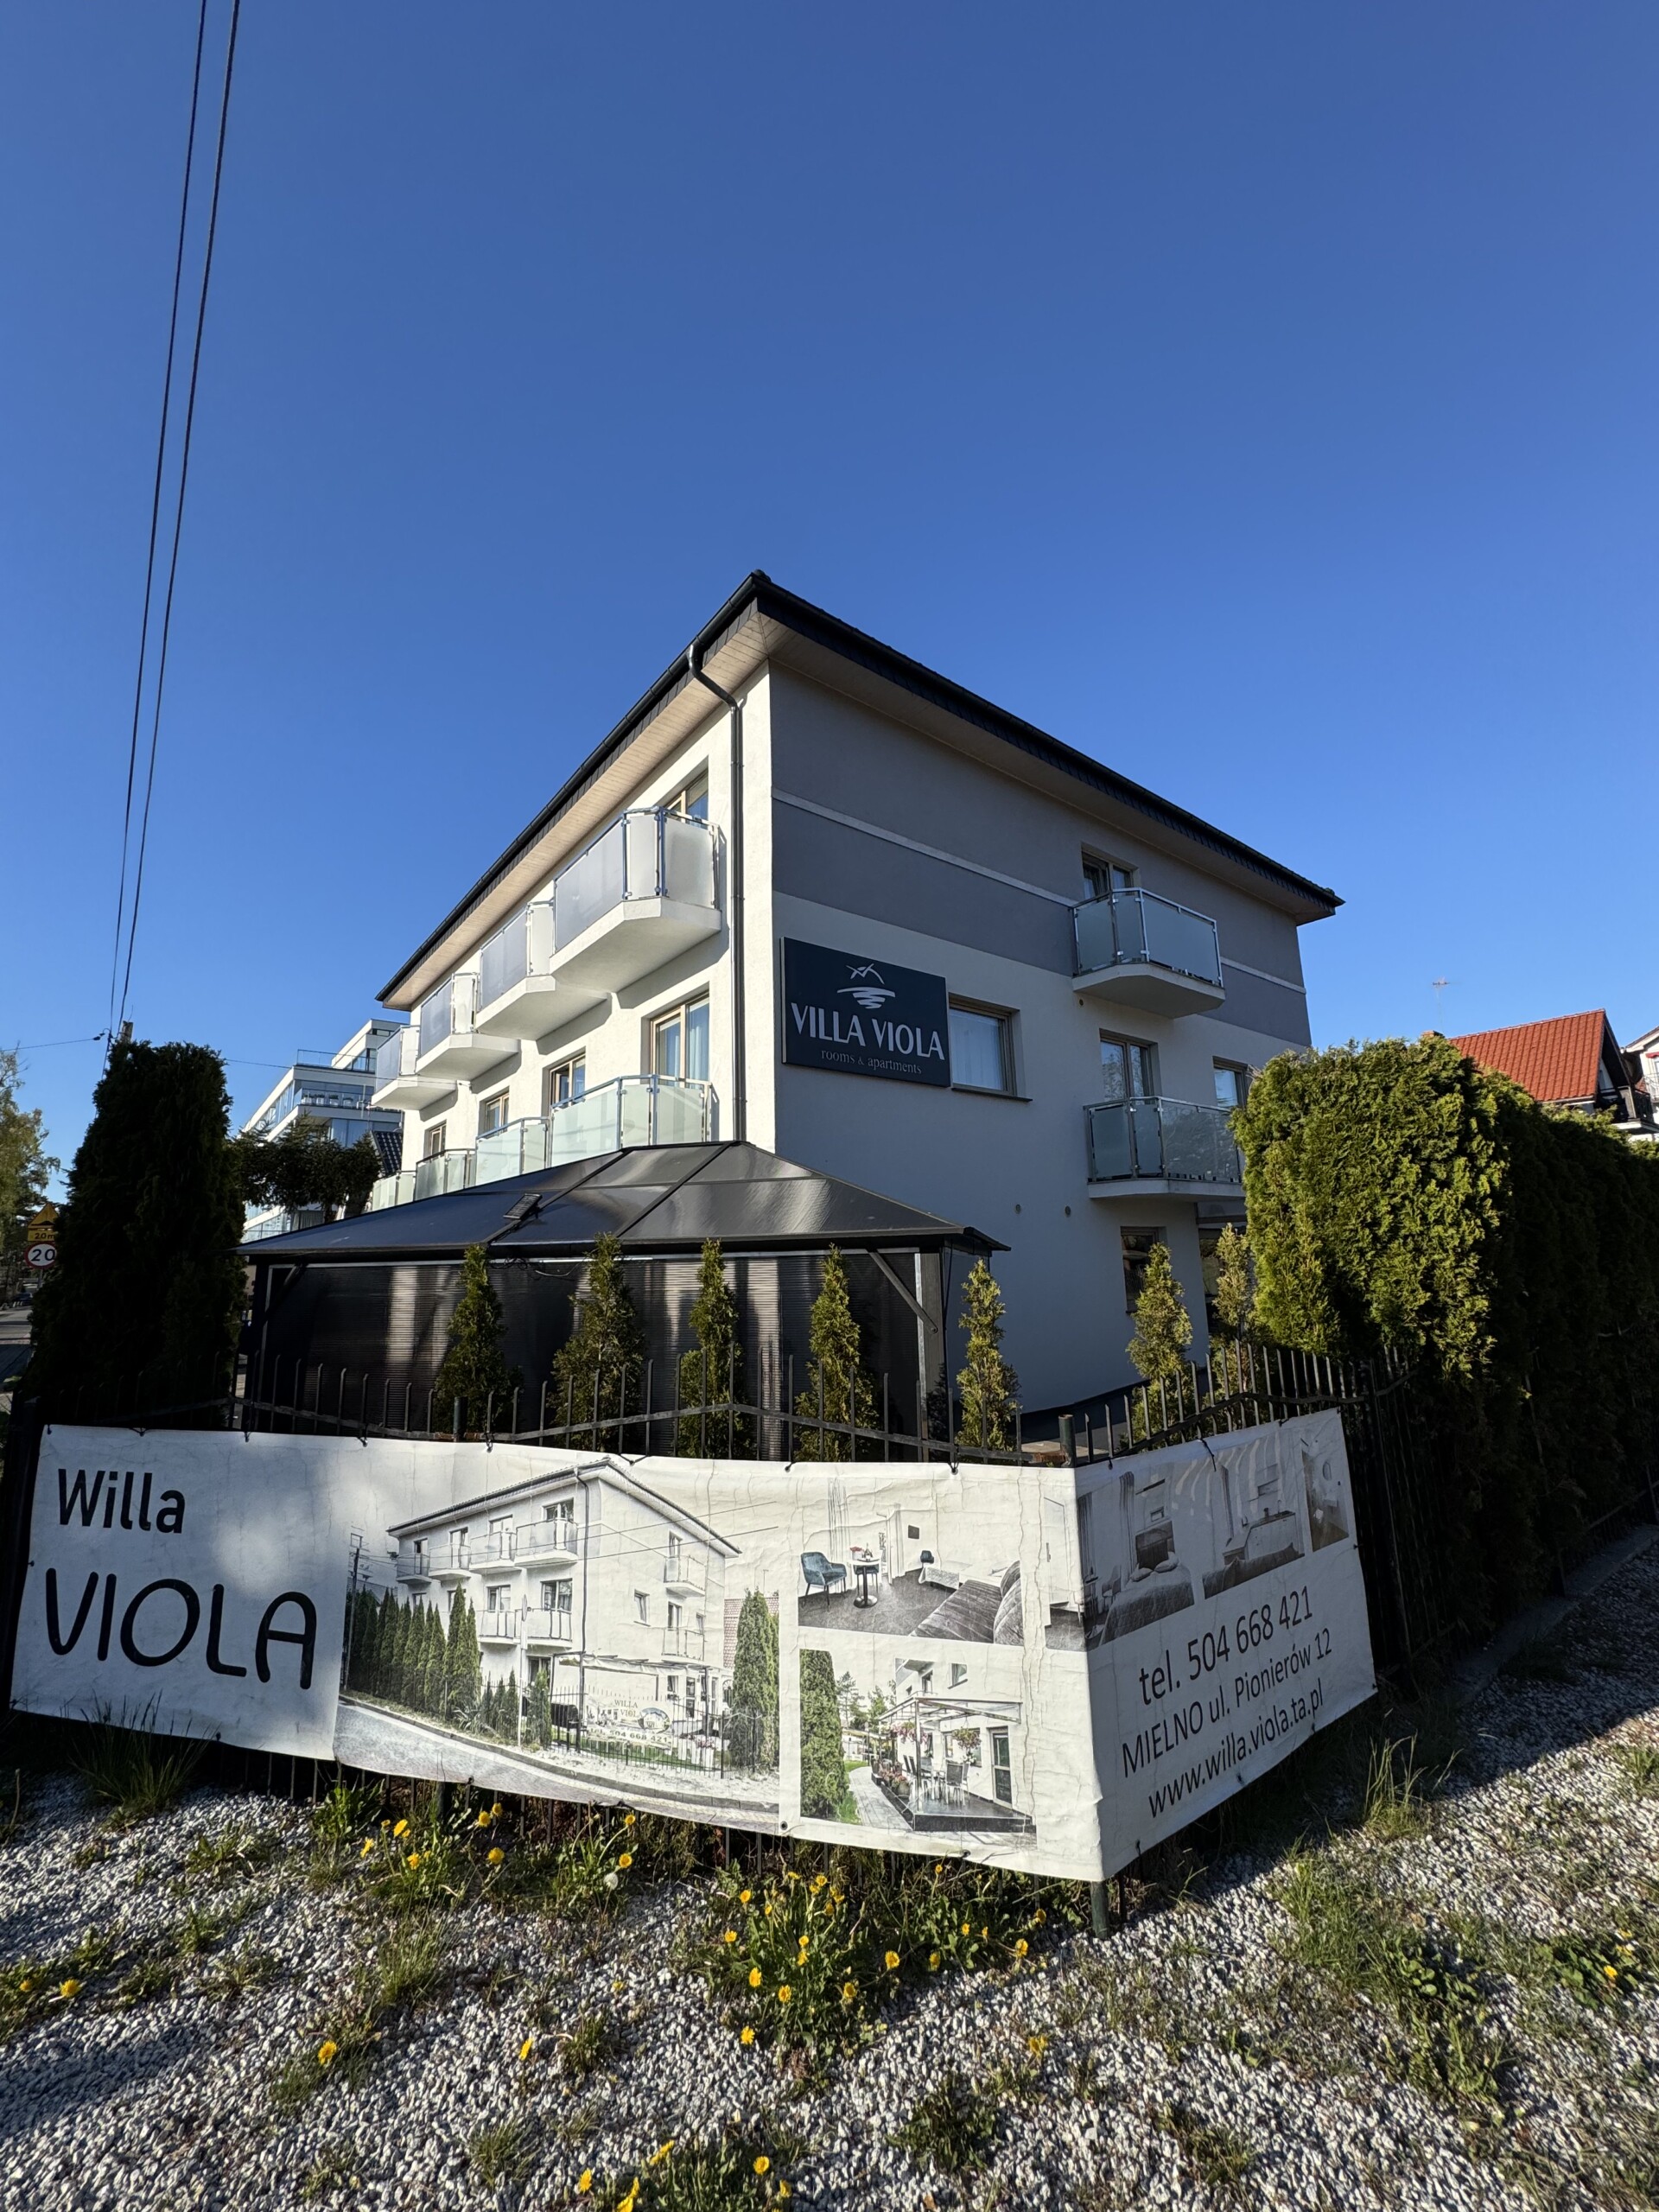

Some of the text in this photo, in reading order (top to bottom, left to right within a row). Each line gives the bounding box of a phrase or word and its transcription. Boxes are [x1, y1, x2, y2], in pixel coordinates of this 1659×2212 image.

[791, 1002, 945, 1060] VILLA VIOLA
[822, 1049, 922, 1074] rooms & apartments
[31, 1249, 56, 1262] 20
[58, 1468, 186, 1534] Willa
[46, 1567, 317, 1690] VIOLA
[1139, 1586, 1313, 1706] tel. 504 668 421
[614, 1700, 638, 1708] WILLA
[1122, 1628, 1332, 1778] MIELNO ul. Pionierów 12
[1148, 1677, 1324, 1818] www.willa.viola.ta.pl
